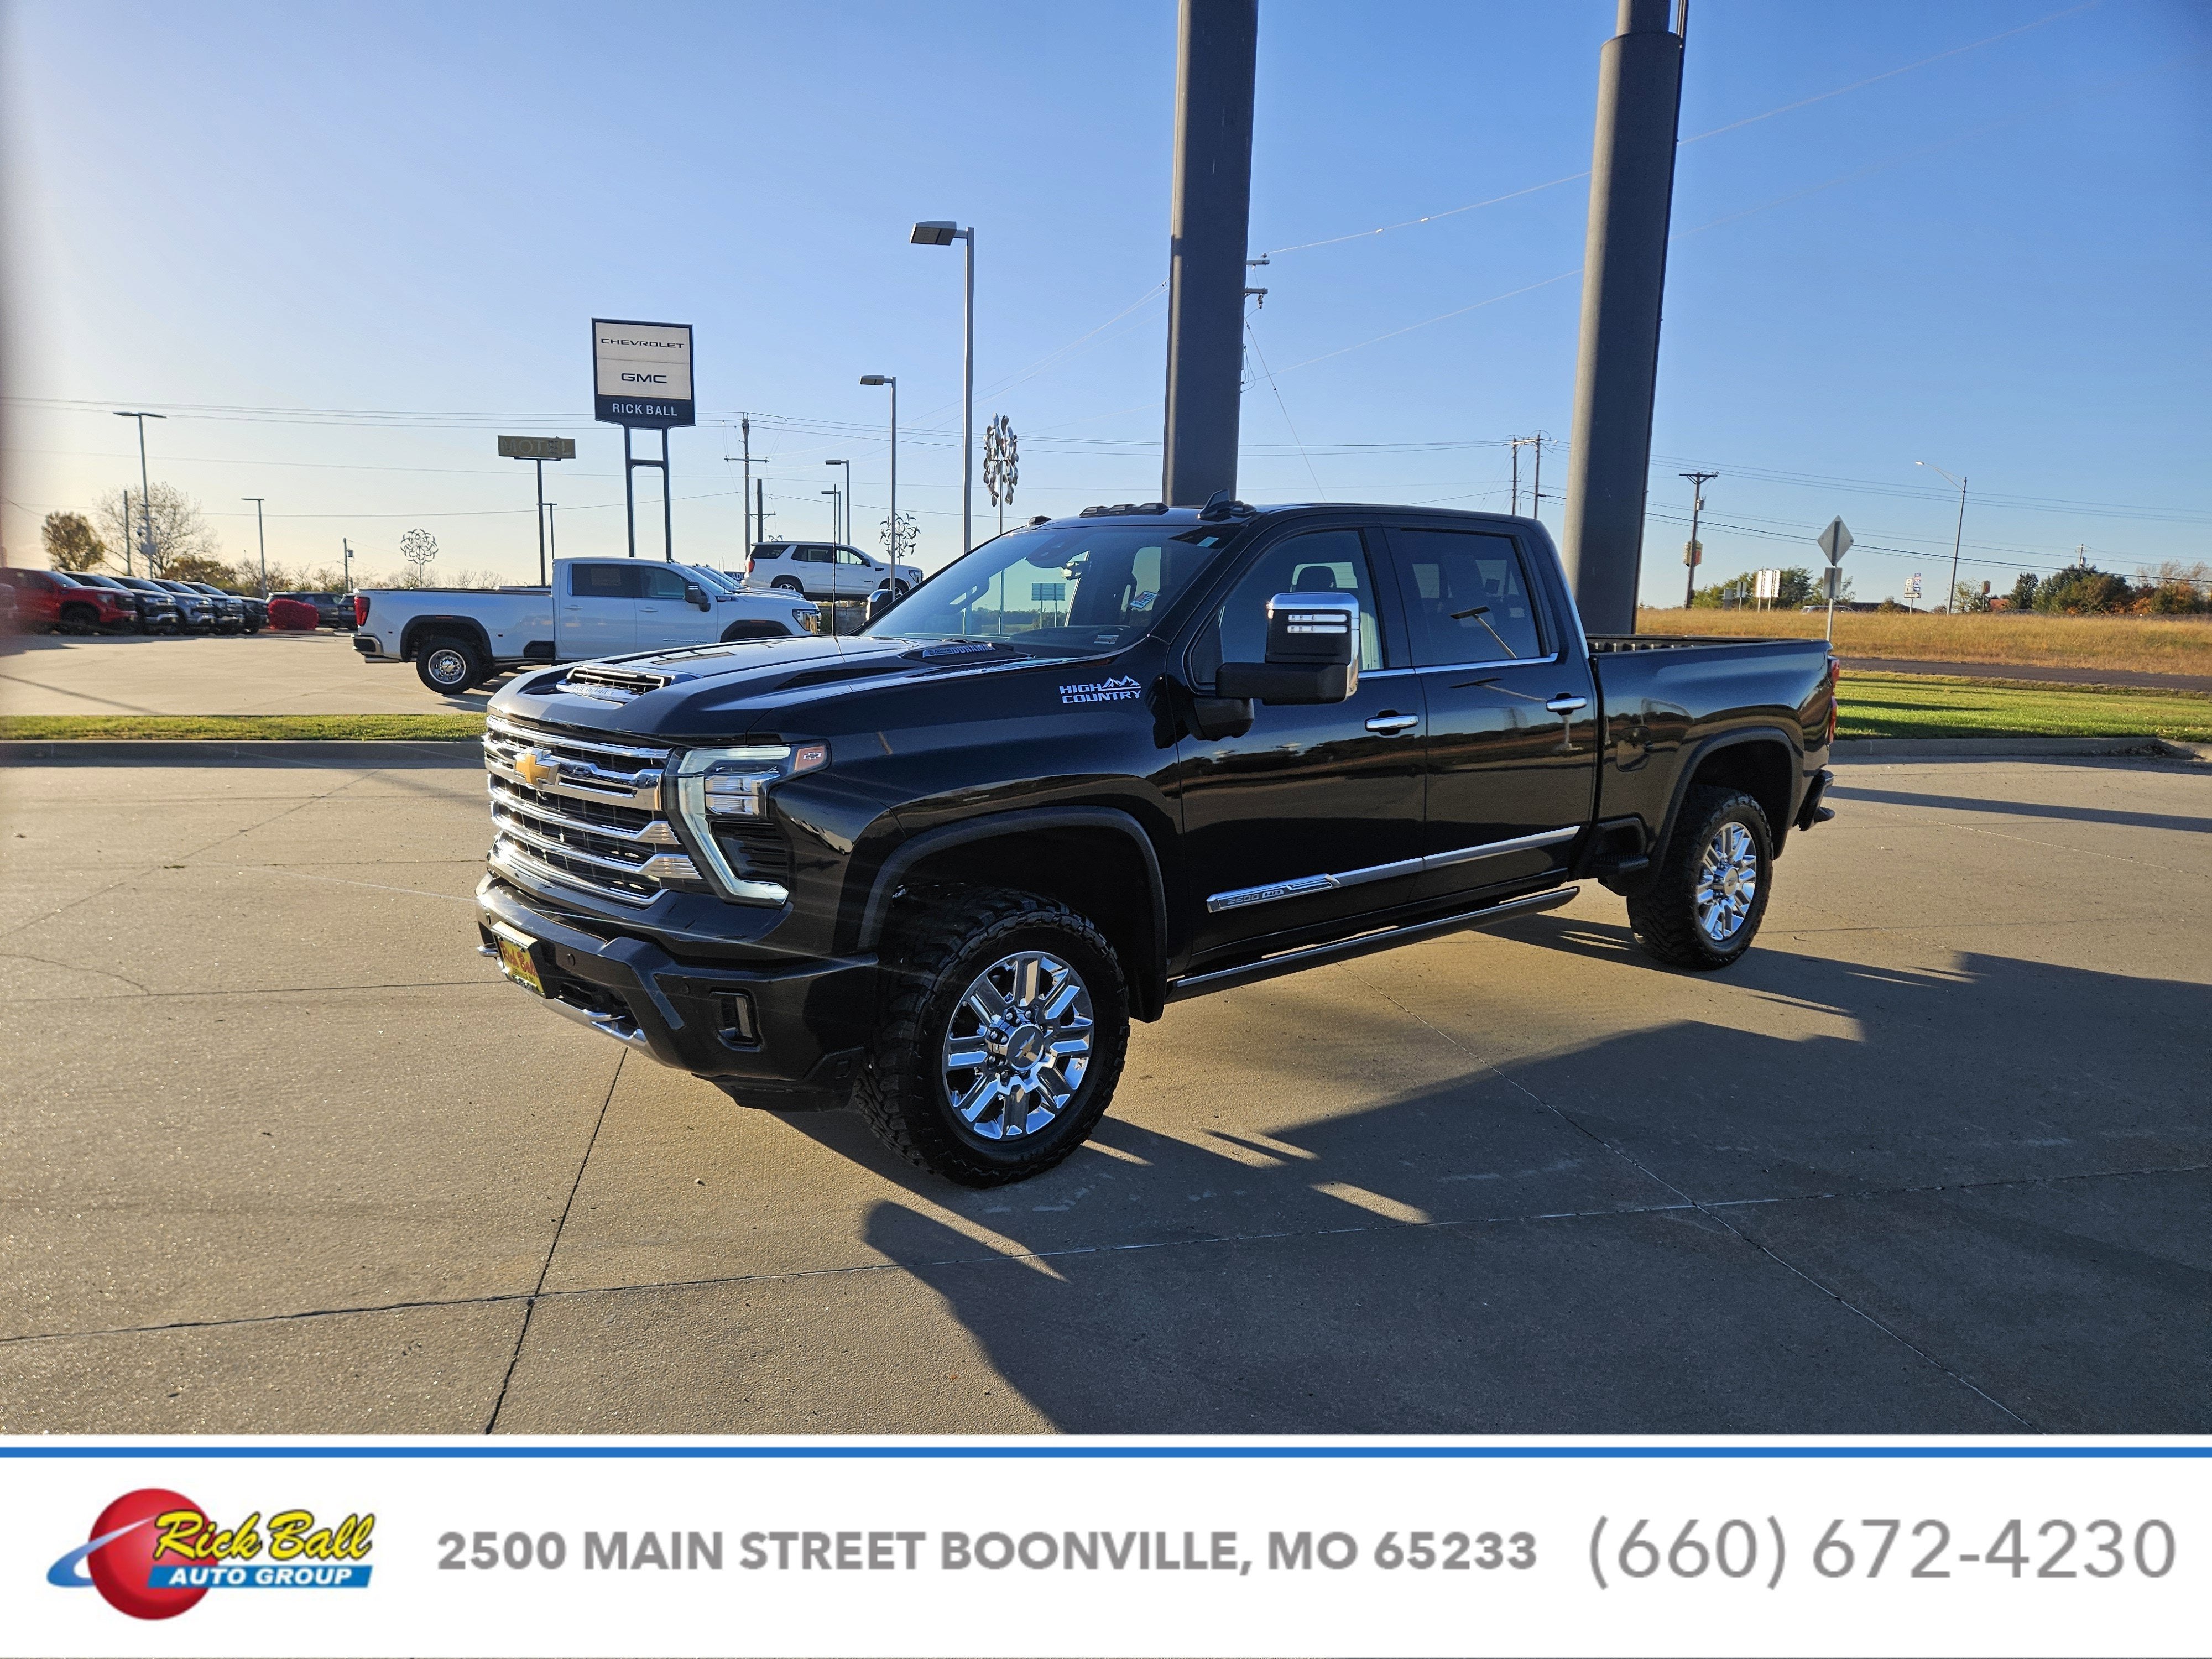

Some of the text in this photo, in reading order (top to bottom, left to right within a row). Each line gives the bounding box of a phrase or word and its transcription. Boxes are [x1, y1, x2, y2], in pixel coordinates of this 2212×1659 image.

[601, 338, 685, 348] CHEVROLET
[621, 373, 667, 384] GMC
[612, 403, 678, 416] RICK BALL
[499, 438, 572, 456] MOTEL
[951, 644, 996, 654] DURAMAX
[1059, 684, 1102, 695] HIGH
[1062, 690, 1141, 703] COUNTRY
